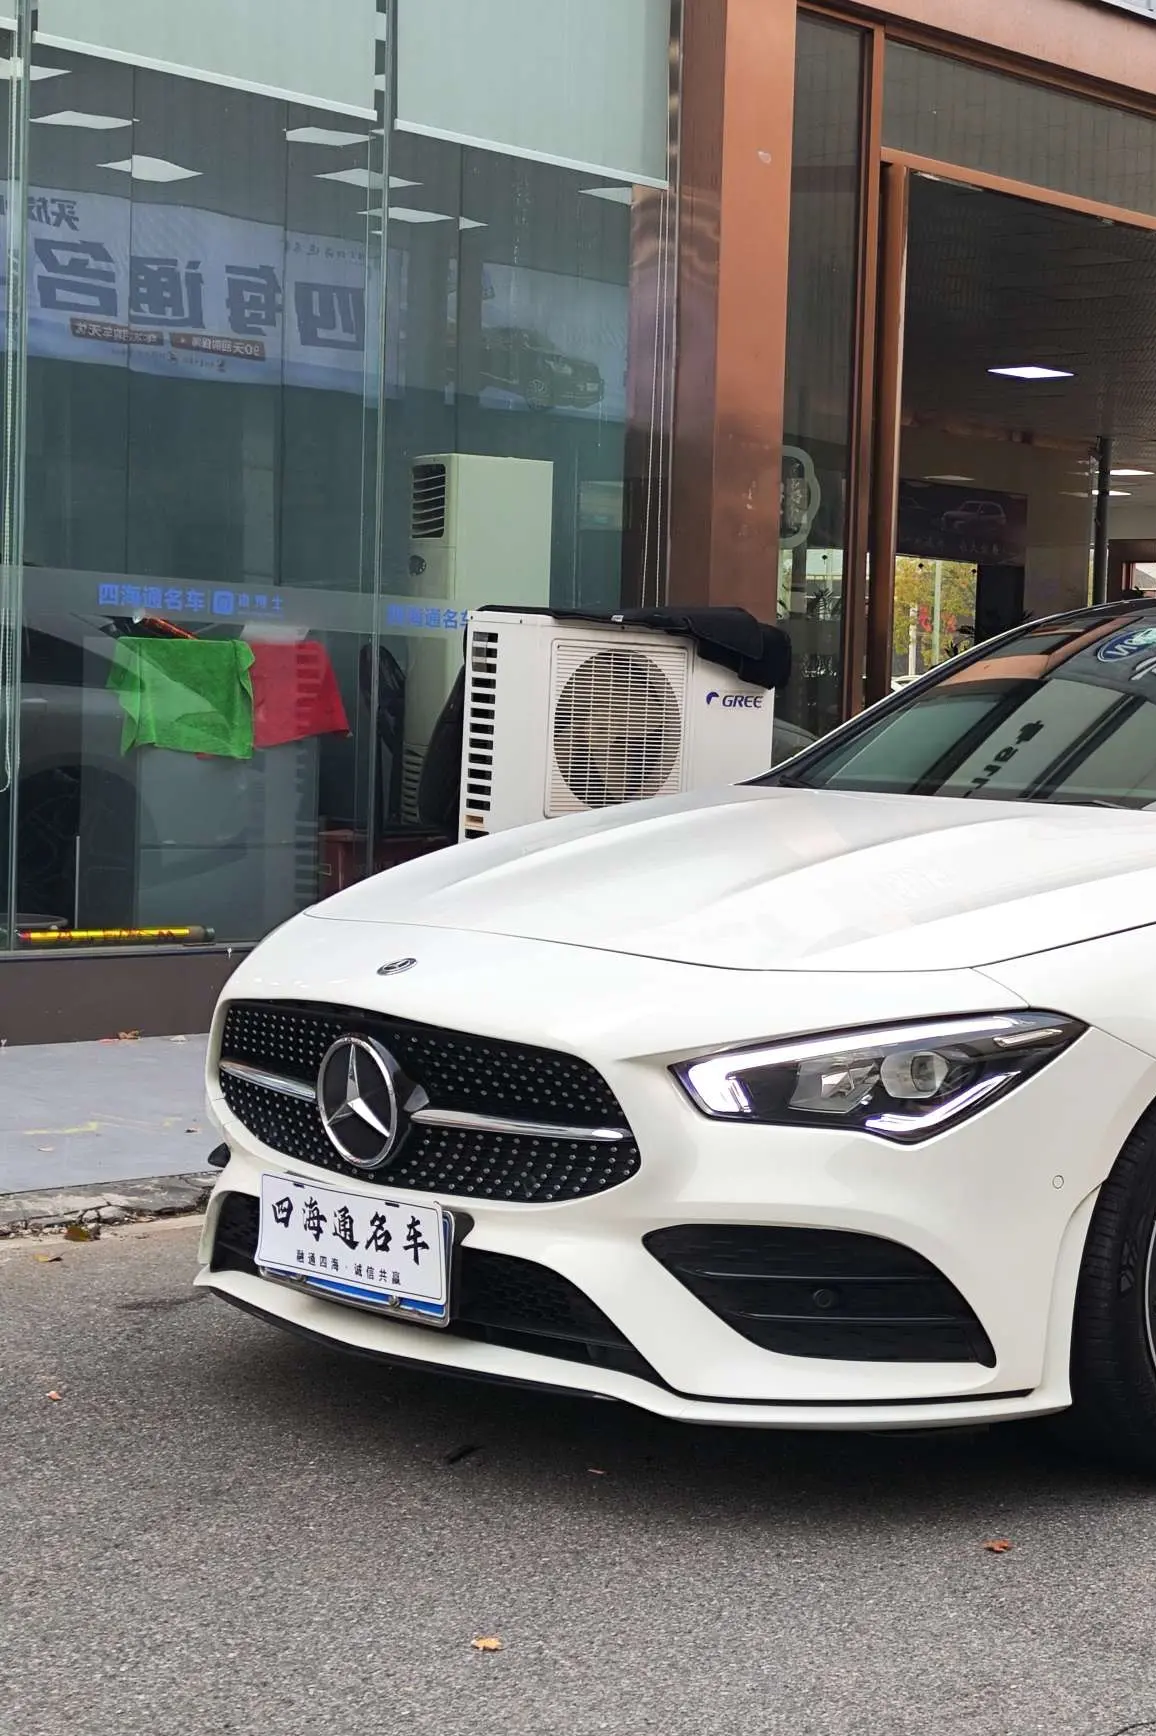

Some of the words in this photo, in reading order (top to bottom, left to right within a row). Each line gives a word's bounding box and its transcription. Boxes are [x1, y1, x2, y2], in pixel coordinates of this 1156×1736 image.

[722, 695, 764, 709] GREE
[271, 1196, 430, 1266] 四海通名车
